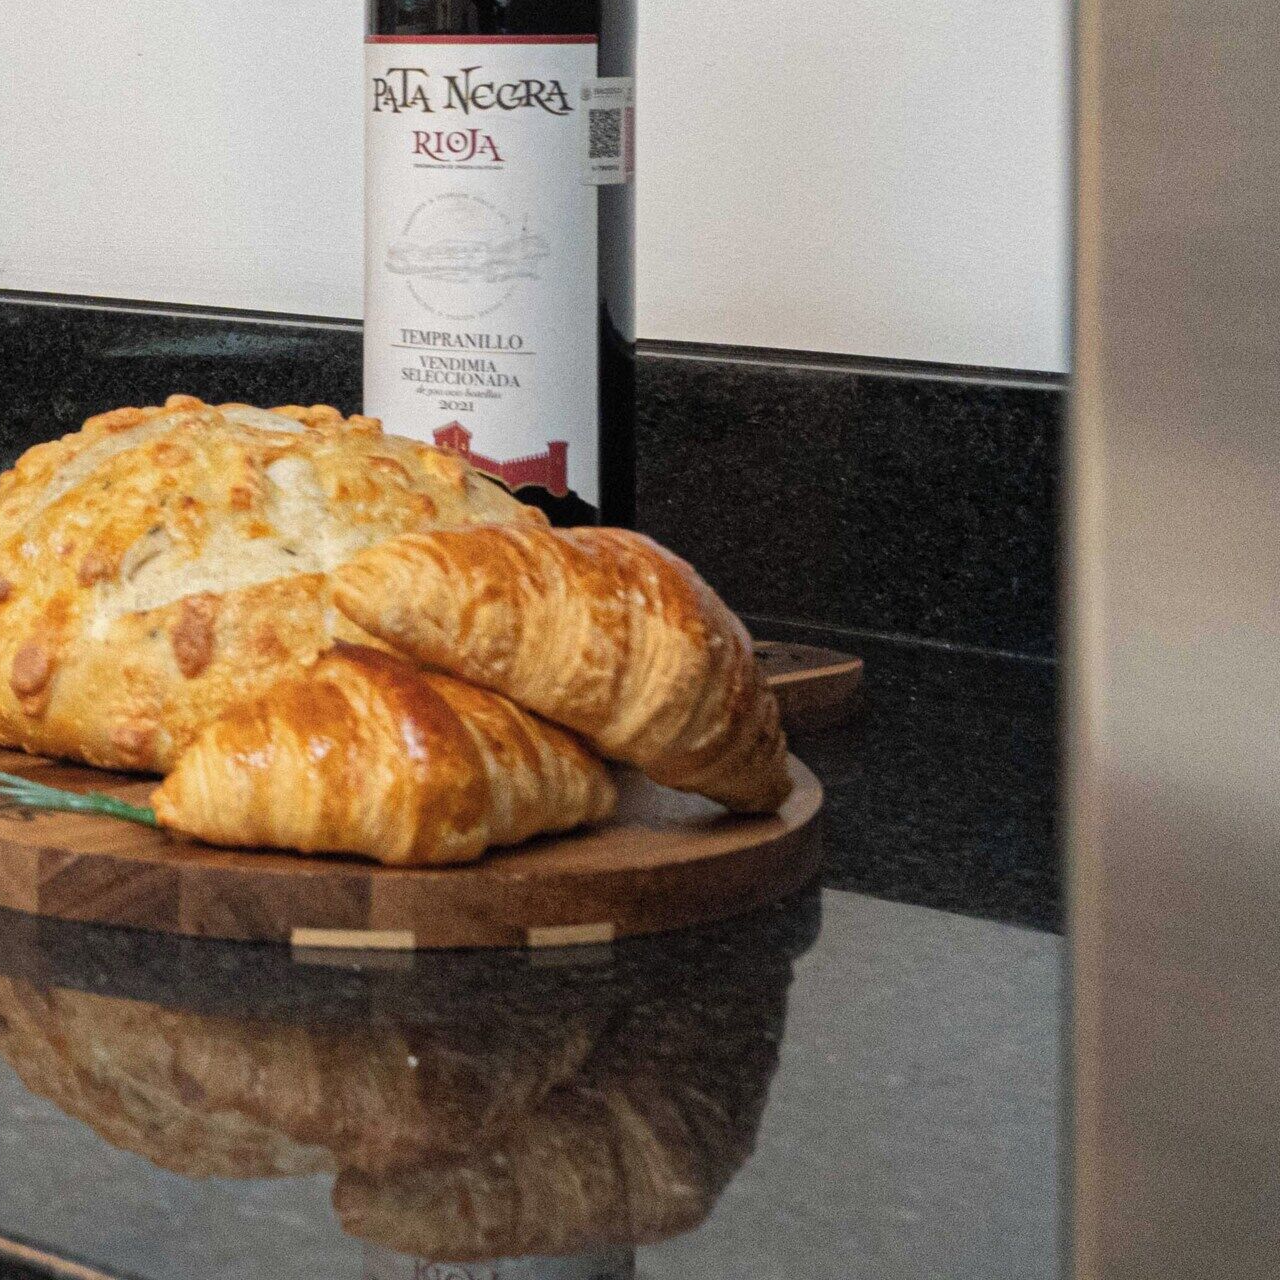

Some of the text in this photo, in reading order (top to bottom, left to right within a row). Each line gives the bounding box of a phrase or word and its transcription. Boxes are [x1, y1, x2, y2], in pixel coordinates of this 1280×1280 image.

[372, 65, 575, 117] PATA NEGRA
[412, 128, 506, 162] RIOJA
[400, 328, 524, 350] TEMPRANILLO
[419, 355, 497, 373] VENDIMIA
[401, 366, 521, 388] SELECCIONADA
[439, 400, 475, 412] 2021
